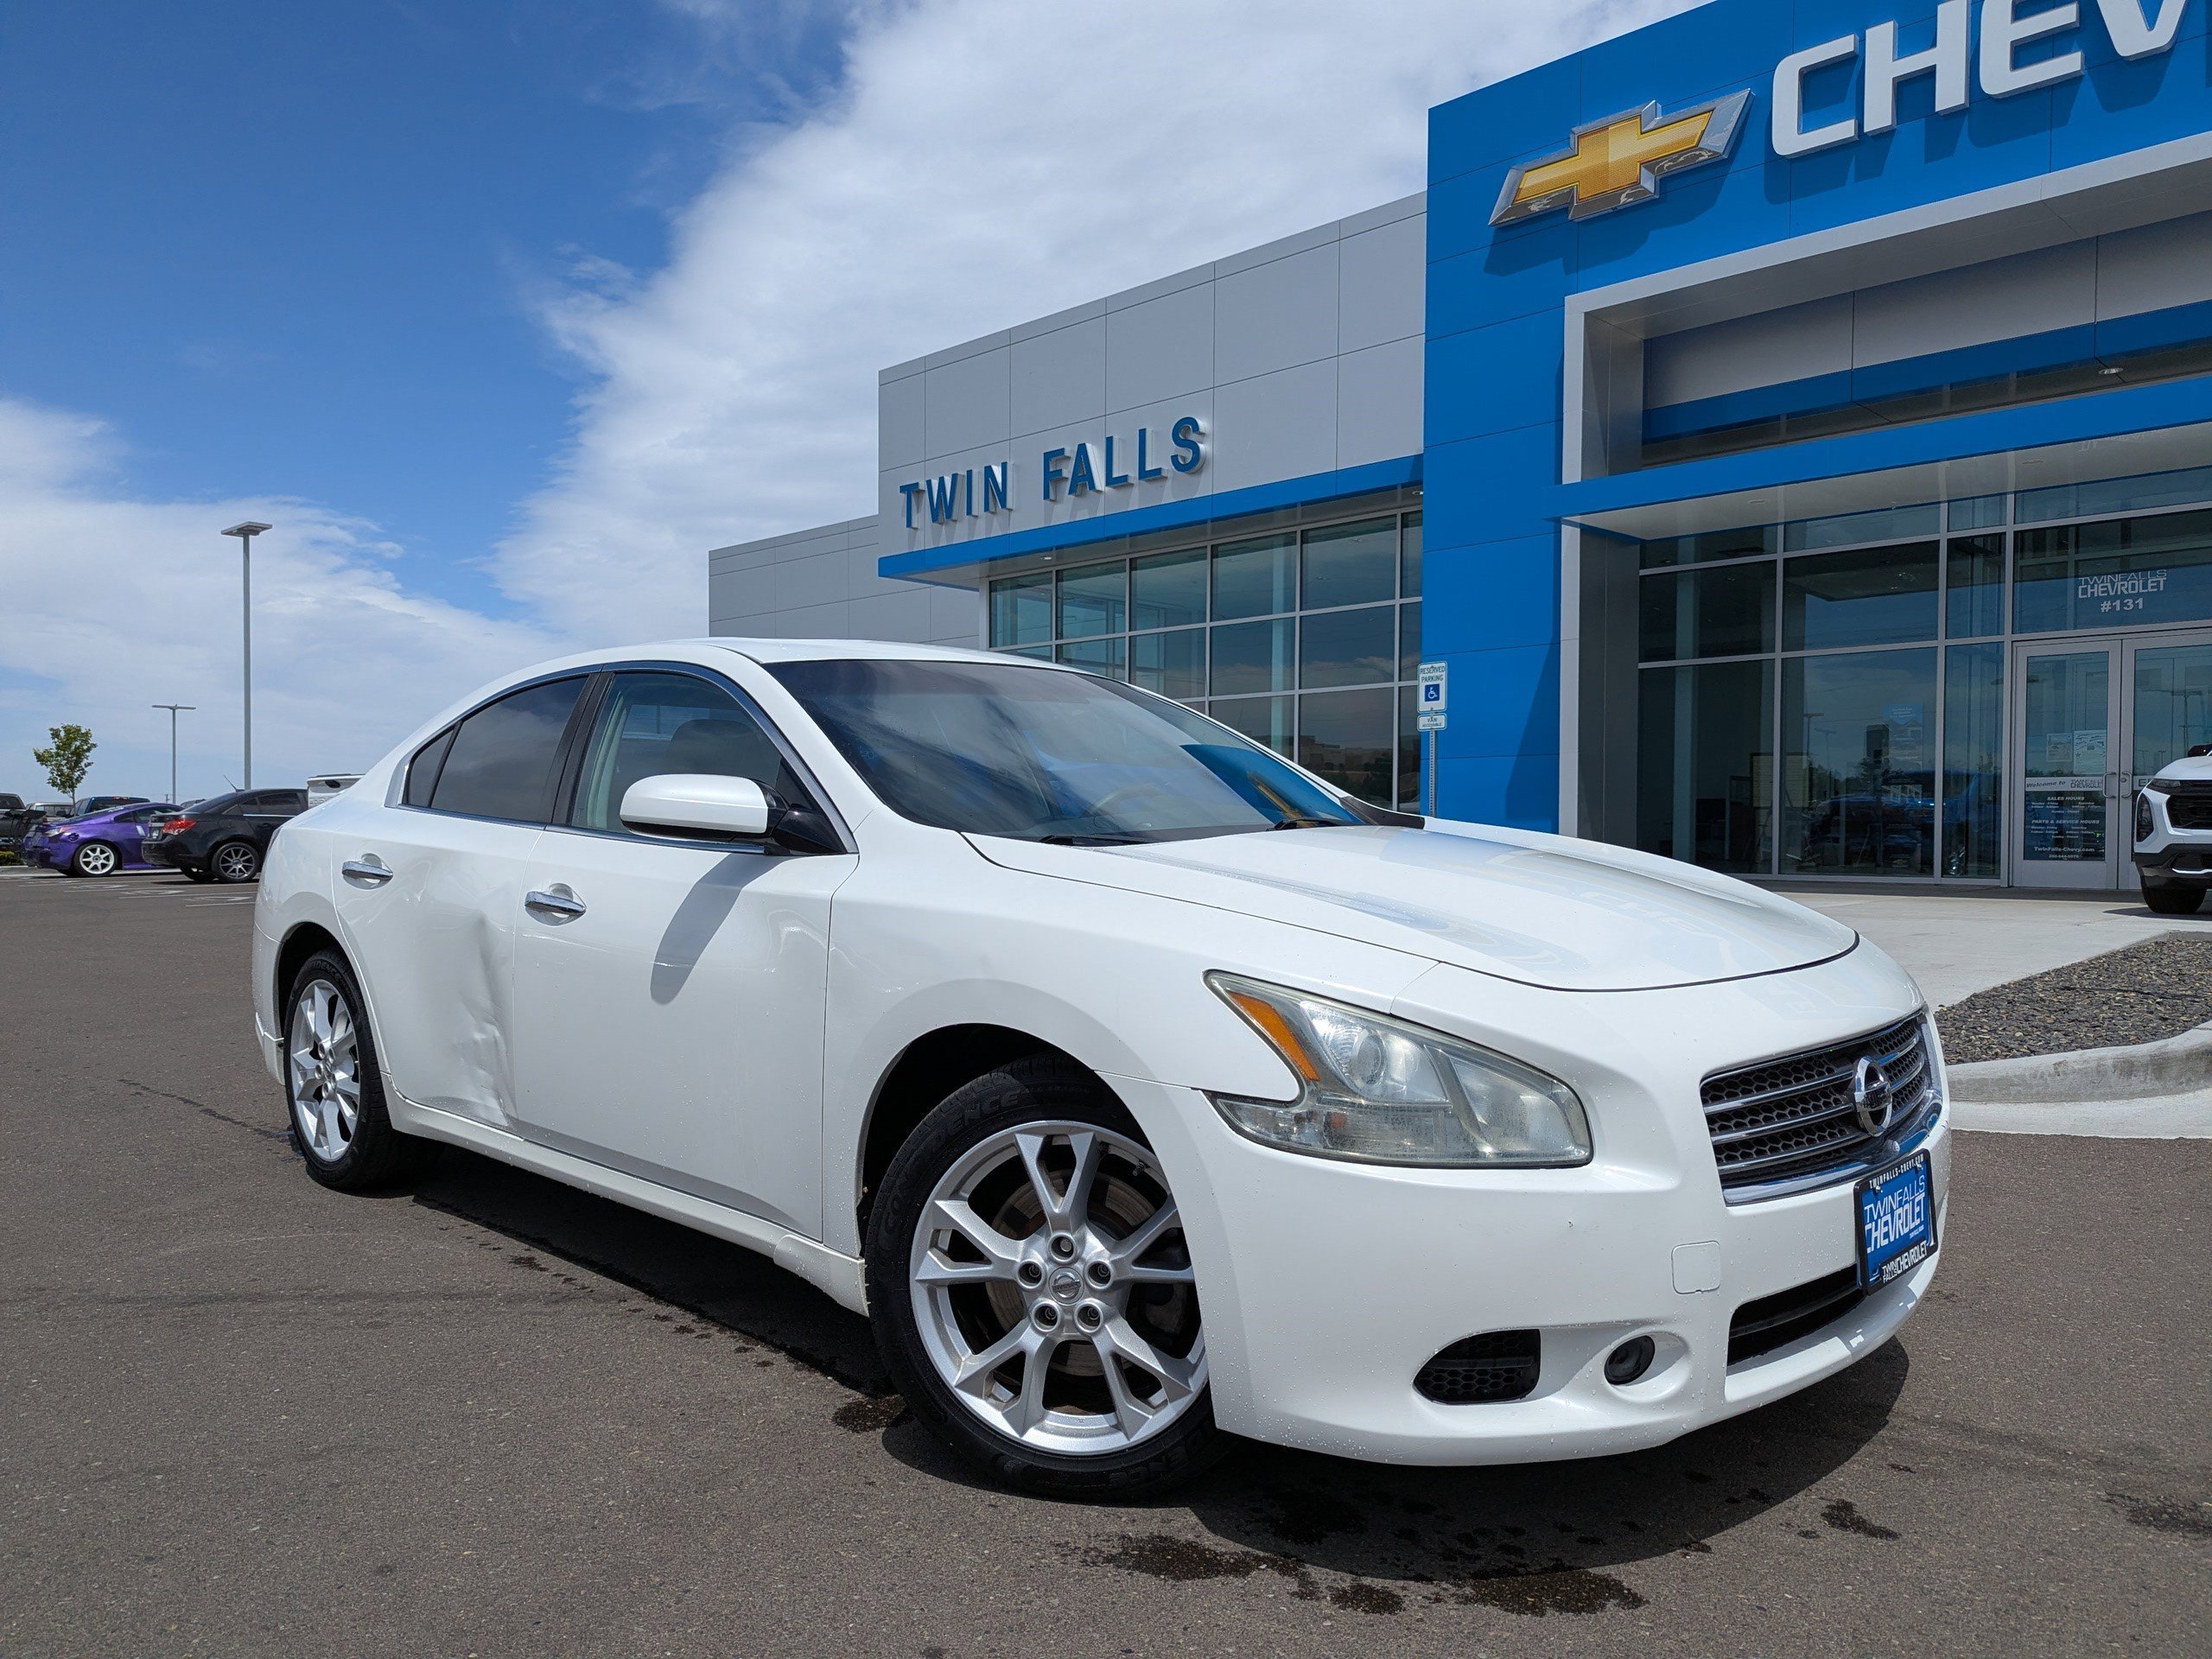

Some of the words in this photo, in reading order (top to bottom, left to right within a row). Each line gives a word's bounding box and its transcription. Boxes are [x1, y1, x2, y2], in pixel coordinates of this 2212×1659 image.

[899, 461, 1015, 530] TWIN
[1043, 416, 1207, 501] FALLS
[2078, 577, 2167, 599] CHEVROLET
[2101, 597, 2144, 613] #131
[1420, 665, 1446, 675] RESERVED
[1421, 674, 1444, 683] PARKING
[1865, 1192, 1926, 1254] CHEVROLET
[1895, 1240, 1928, 1274] CHEVROLET
